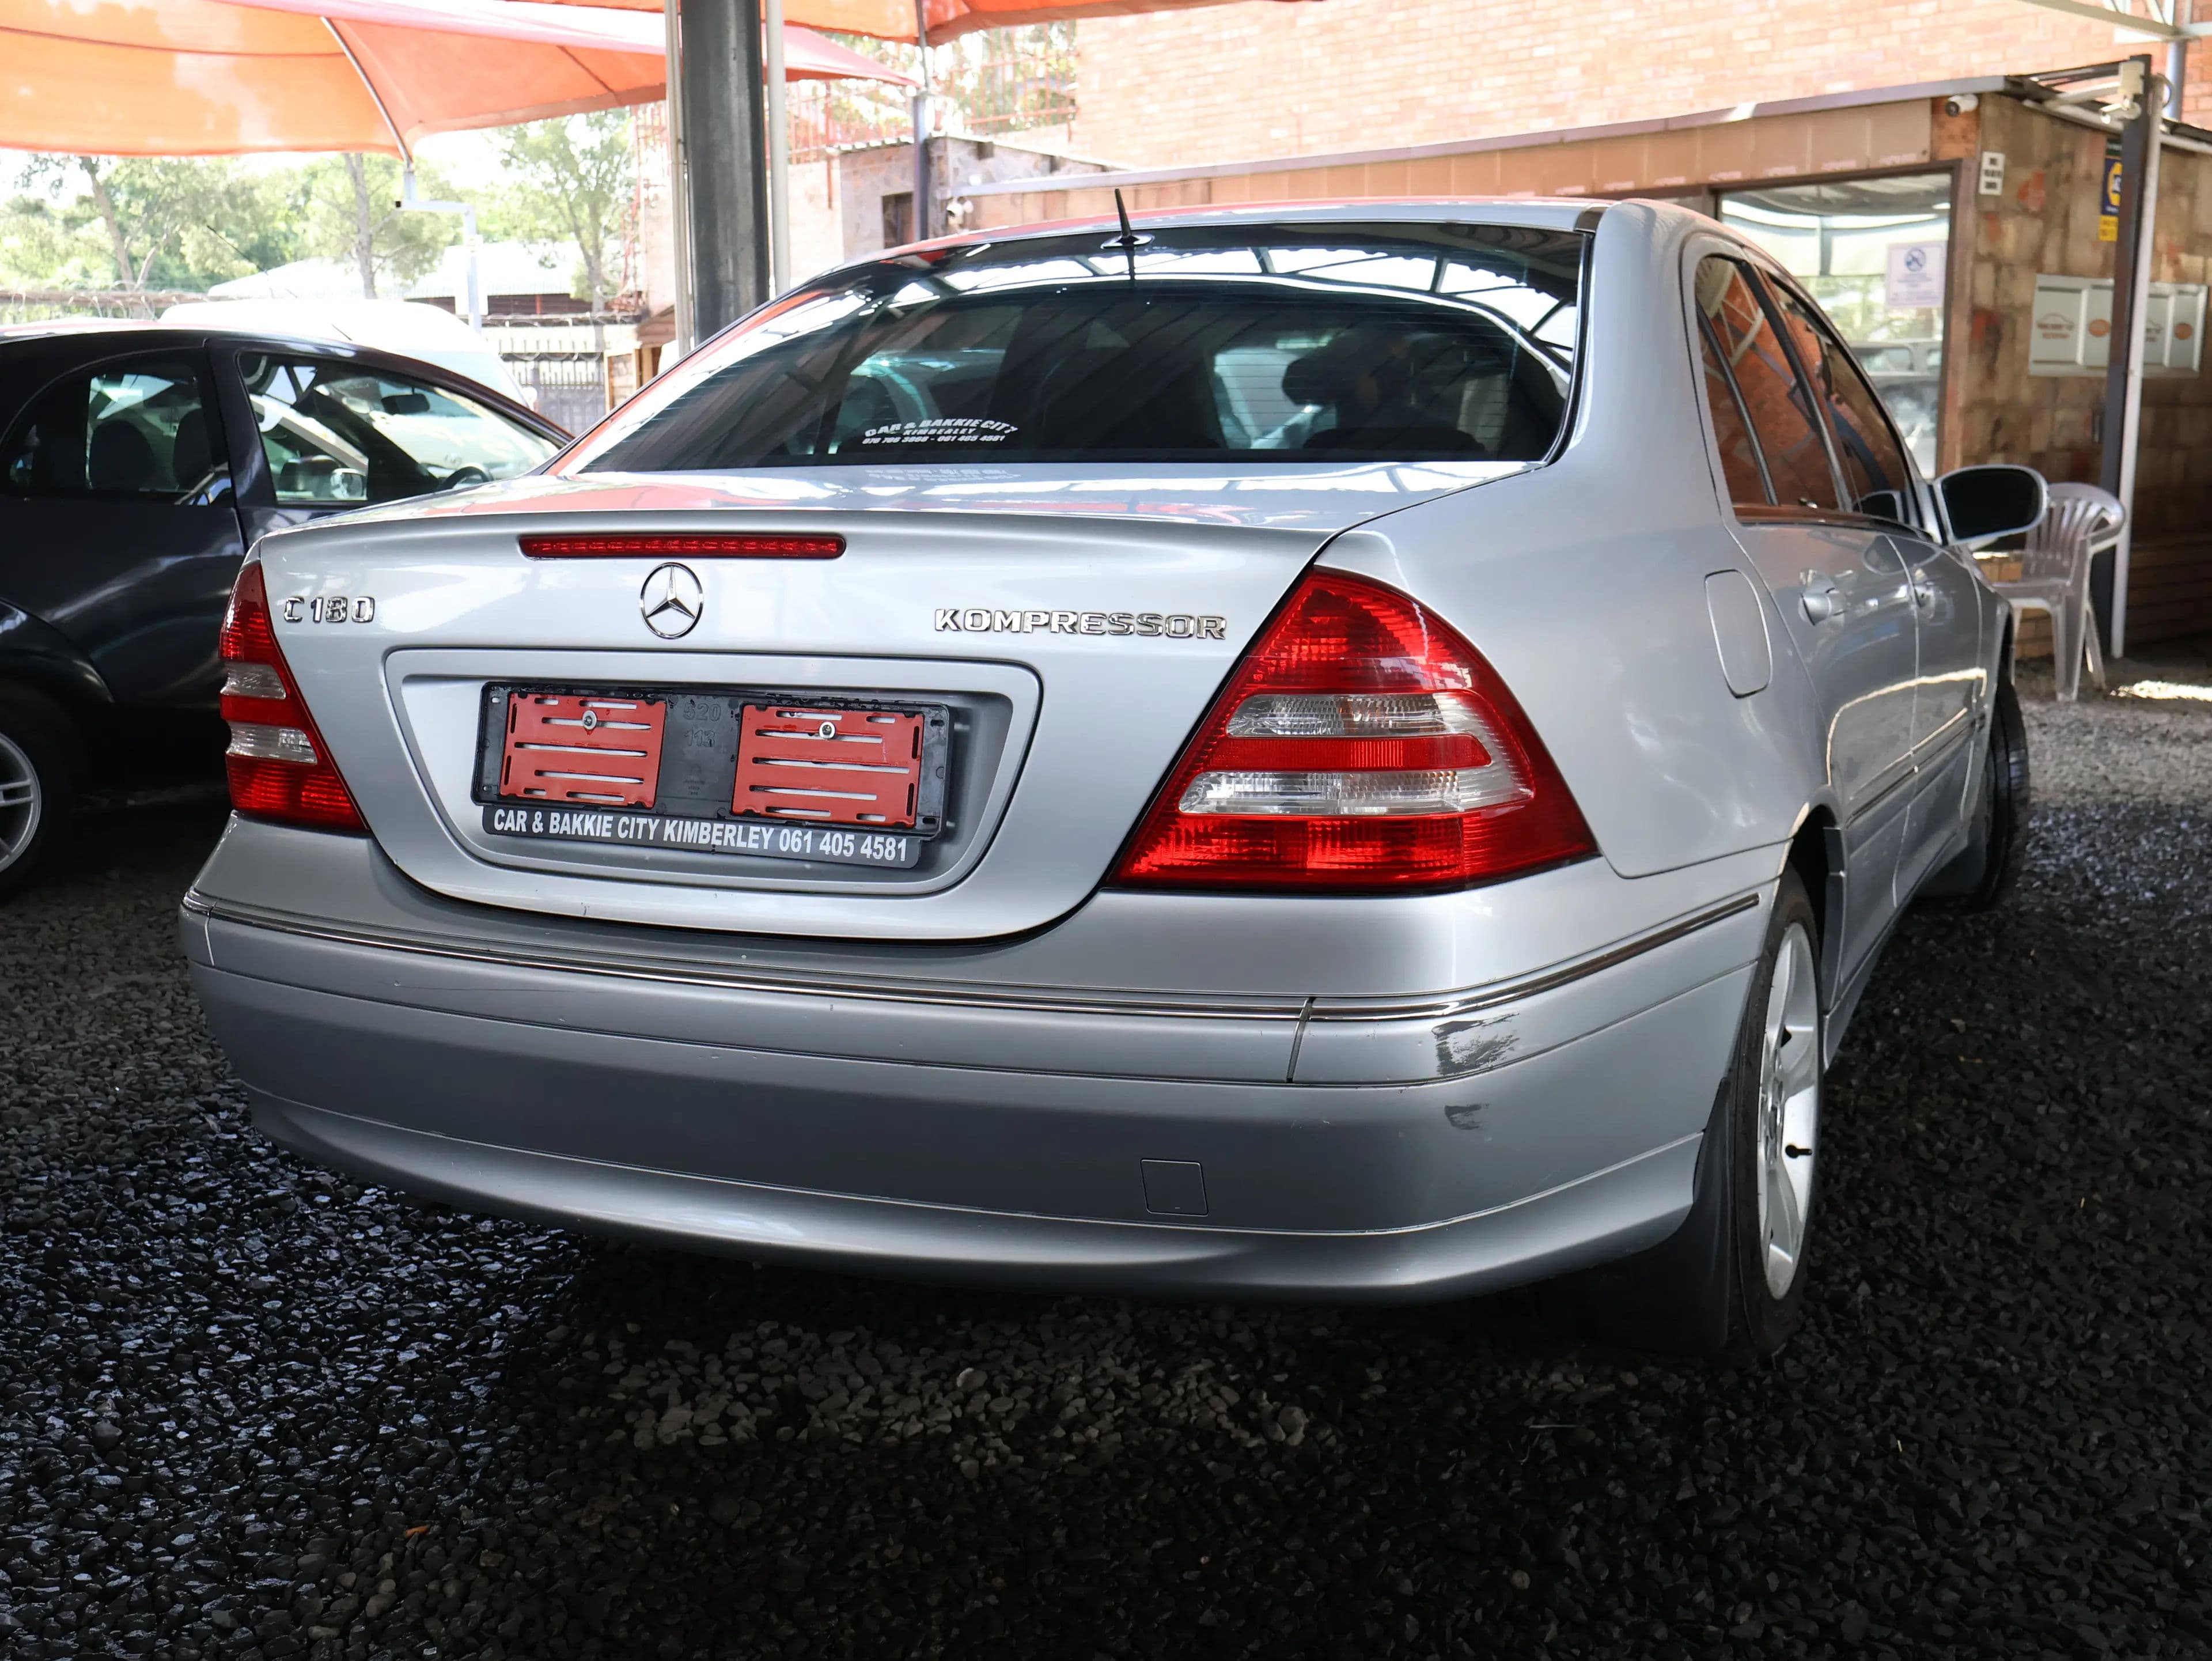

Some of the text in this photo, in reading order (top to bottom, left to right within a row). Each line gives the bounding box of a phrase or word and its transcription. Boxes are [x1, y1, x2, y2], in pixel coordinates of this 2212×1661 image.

[865, 423, 902, 437] CAR
[919, 419, 982, 427] BAKKIE
[980, 420, 1018, 434] CITY
[934, 609, 1227, 640] KOMPRESSOR
[683, 702, 721, 721] 520
[684, 728, 715, 747] 113
[494, 809, 907, 861] CAR & BAKKIE CITY KIMBERLEY 061 405 4581
